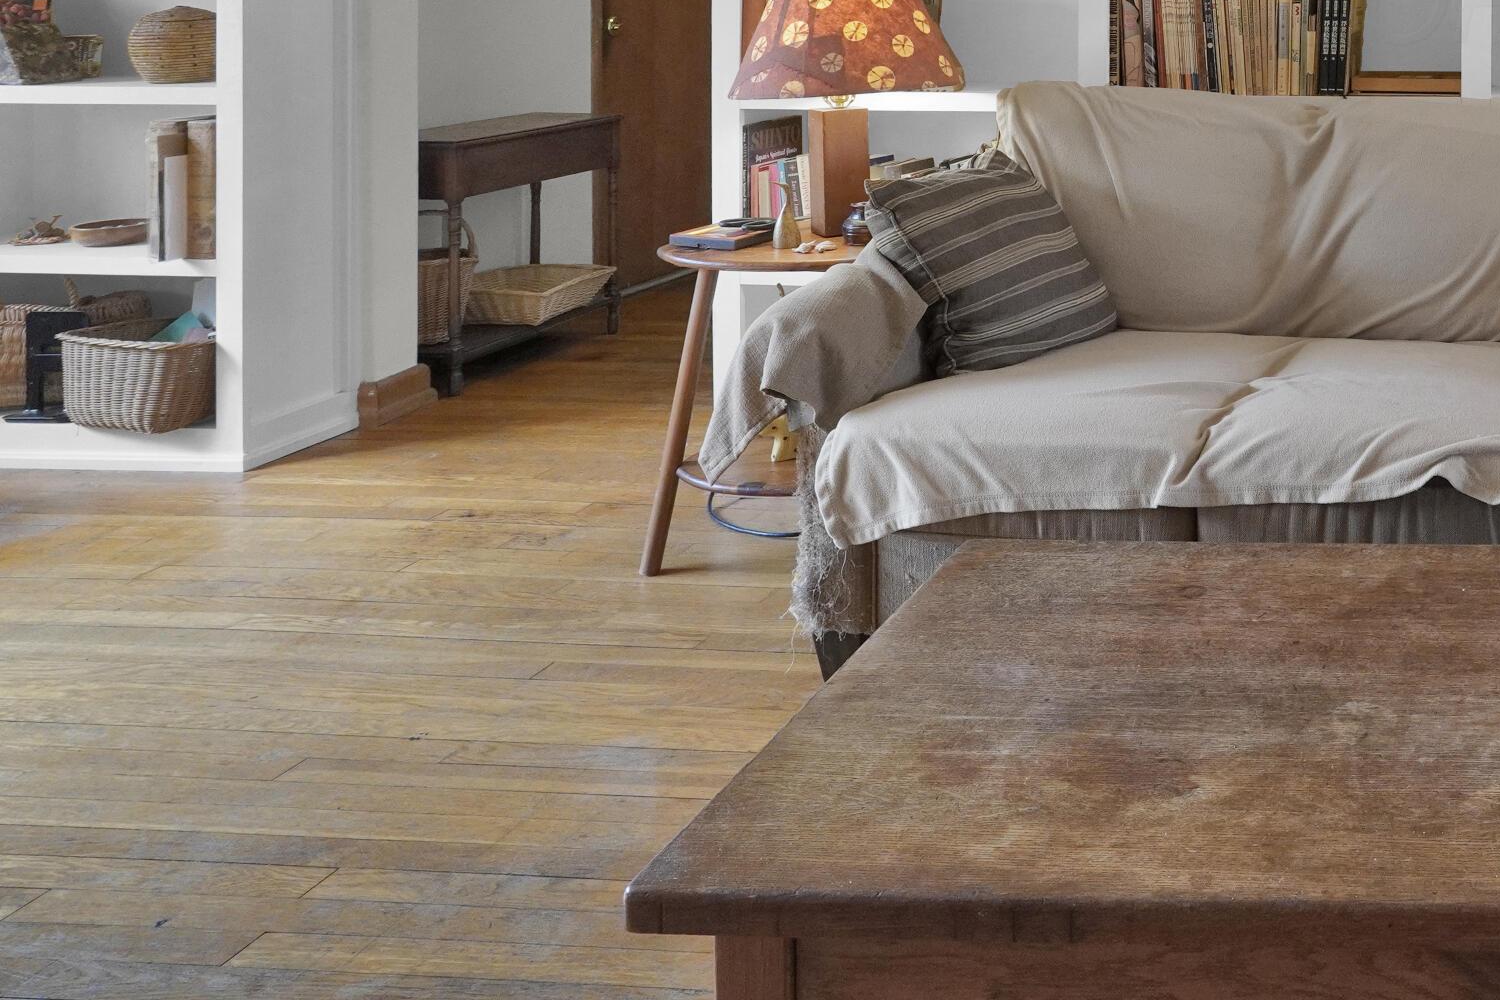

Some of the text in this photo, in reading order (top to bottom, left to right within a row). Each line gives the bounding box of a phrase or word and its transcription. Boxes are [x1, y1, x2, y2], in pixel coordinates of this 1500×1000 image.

[1110, 17, 1118, 28] THE
[1110, 29, 1118, 55] FLOATING
[1110, 57, 1118, 77] WORLD
[752, 124, 801, 151] SHINTO
[756, 153, 769, 162] Japan's
